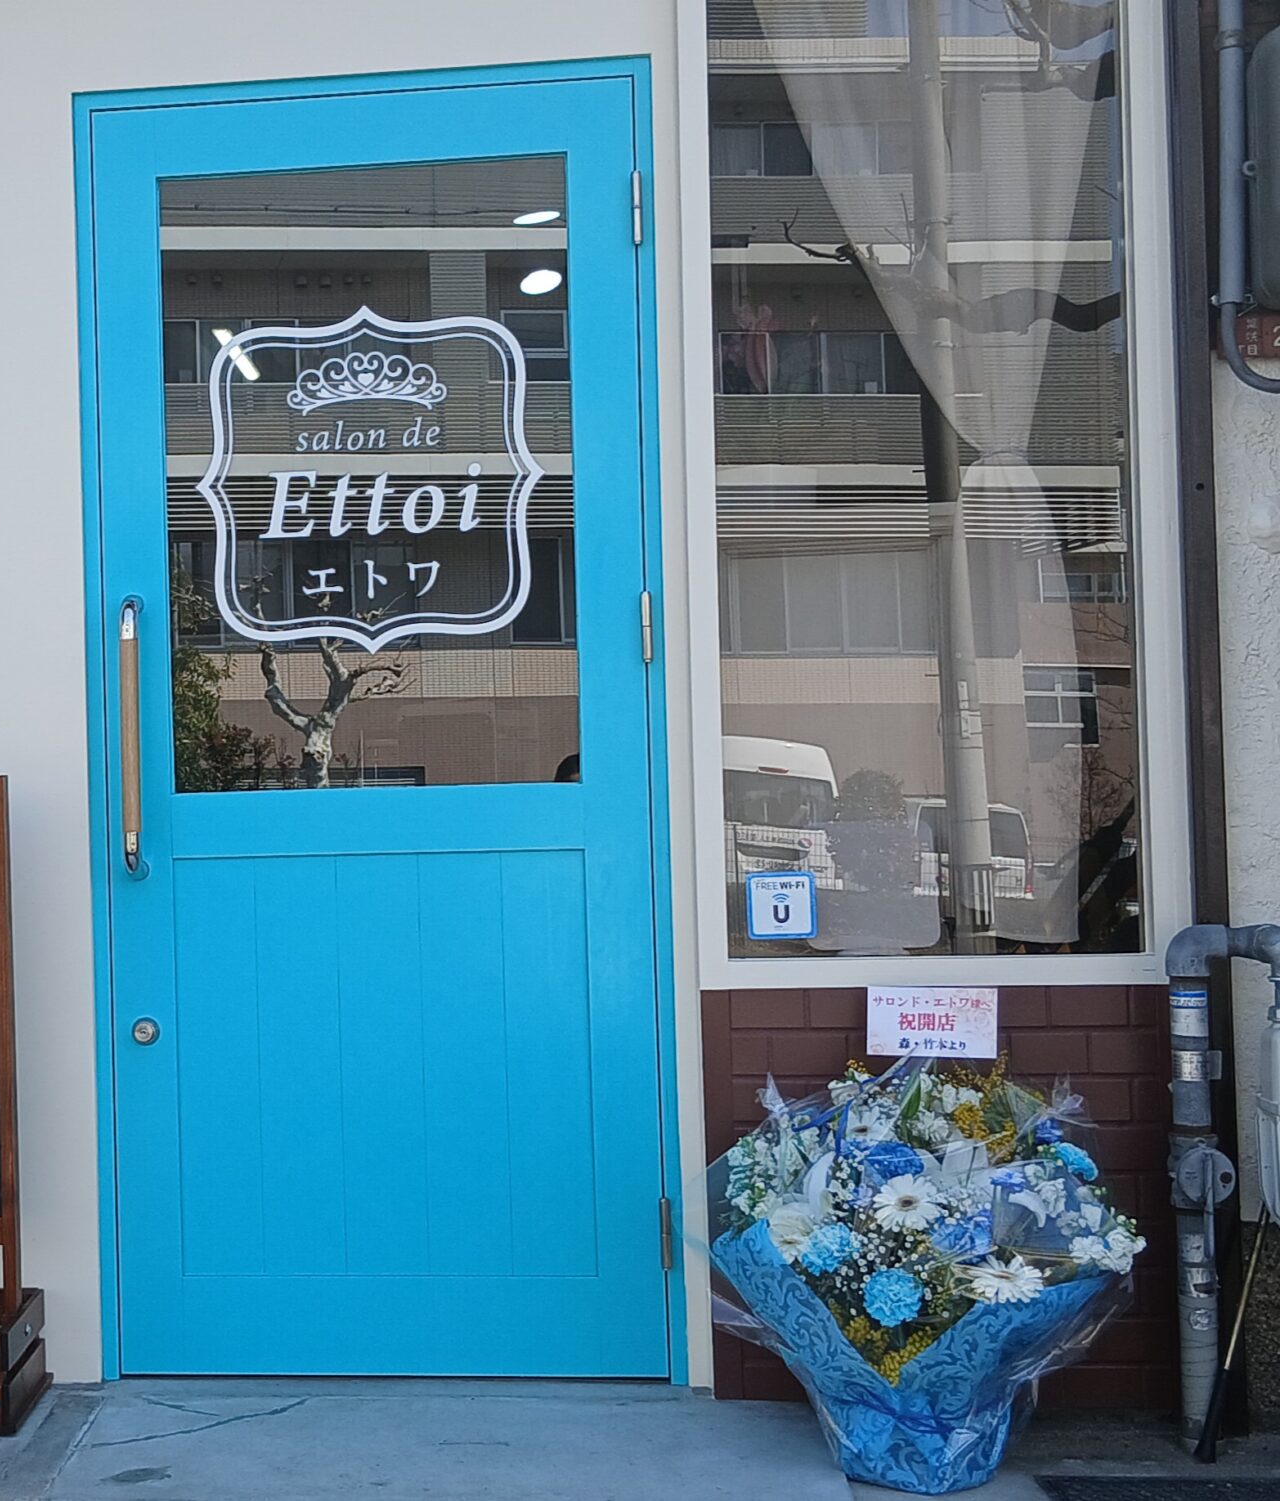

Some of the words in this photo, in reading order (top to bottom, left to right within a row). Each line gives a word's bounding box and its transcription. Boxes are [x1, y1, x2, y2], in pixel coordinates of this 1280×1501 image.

[295, 421, 386, 452] salon
[402, 417, 441, 447] de
[259, 462, 481, 539] Ettoi
[302, 559, 441, 599] エトワ
[755, 881, 779, 891] FREE
[897, 1012, 958, 1032] 祝開店
